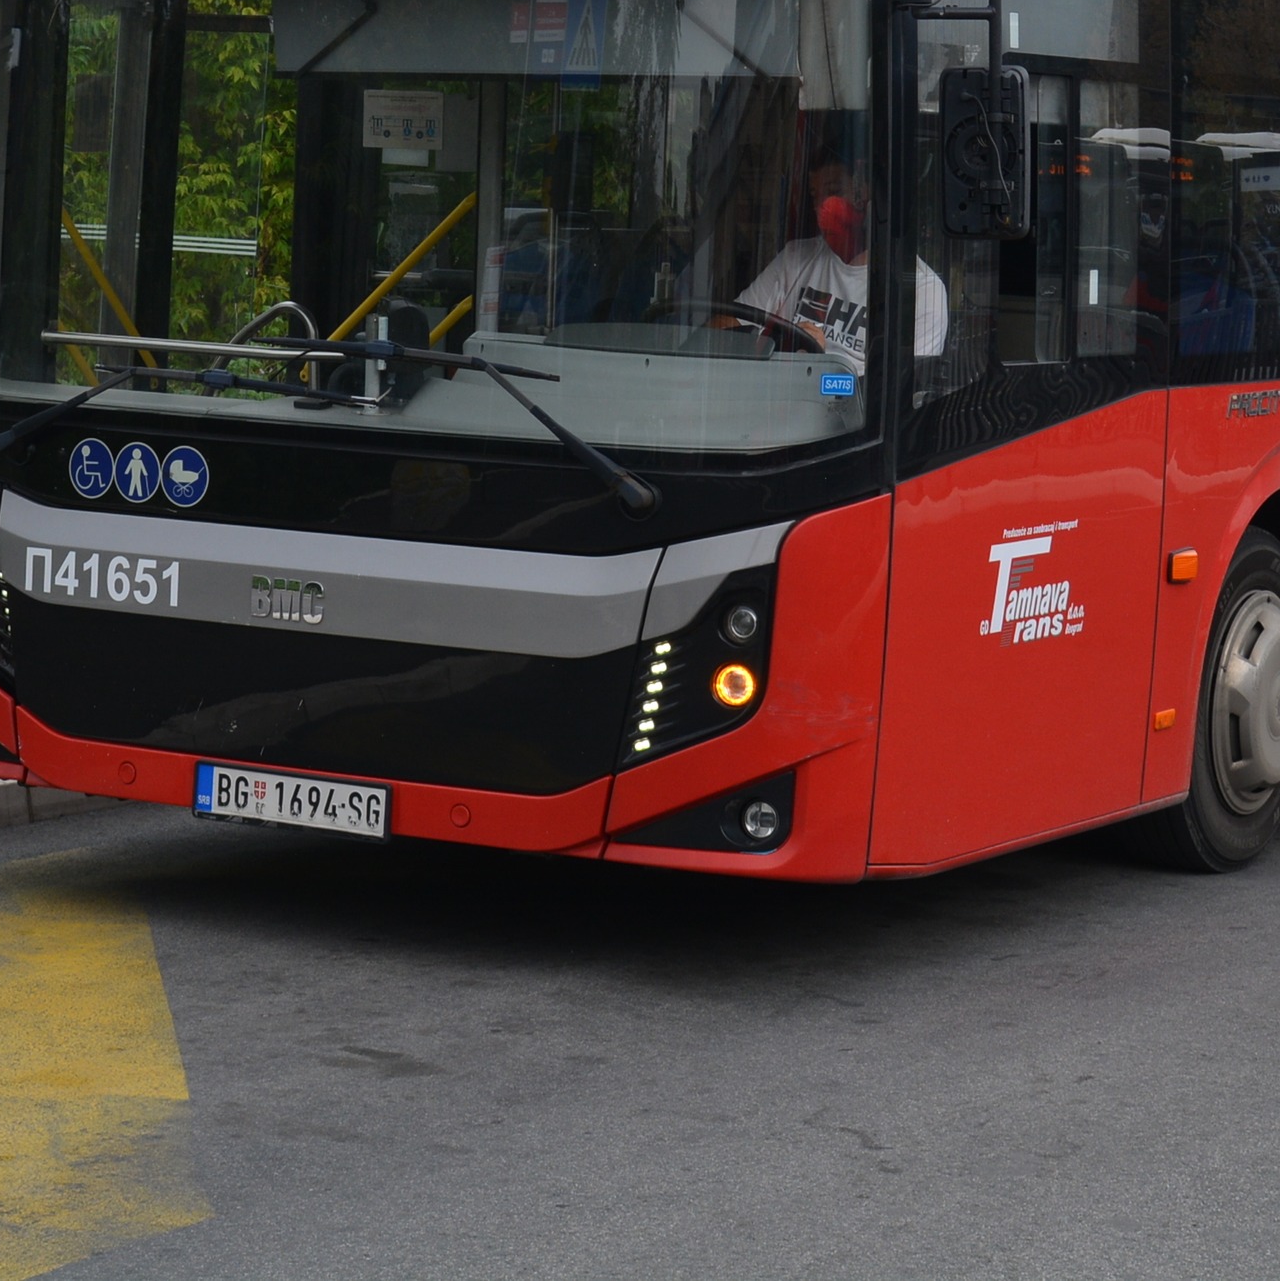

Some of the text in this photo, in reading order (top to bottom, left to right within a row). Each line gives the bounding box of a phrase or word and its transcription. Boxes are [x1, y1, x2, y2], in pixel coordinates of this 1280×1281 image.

[25, 547, 180, 607] П41651
[251, 574, 325, 625] BMC
[198, 794, 211, 805] SRB
[218, 773, 249, 809] BG
